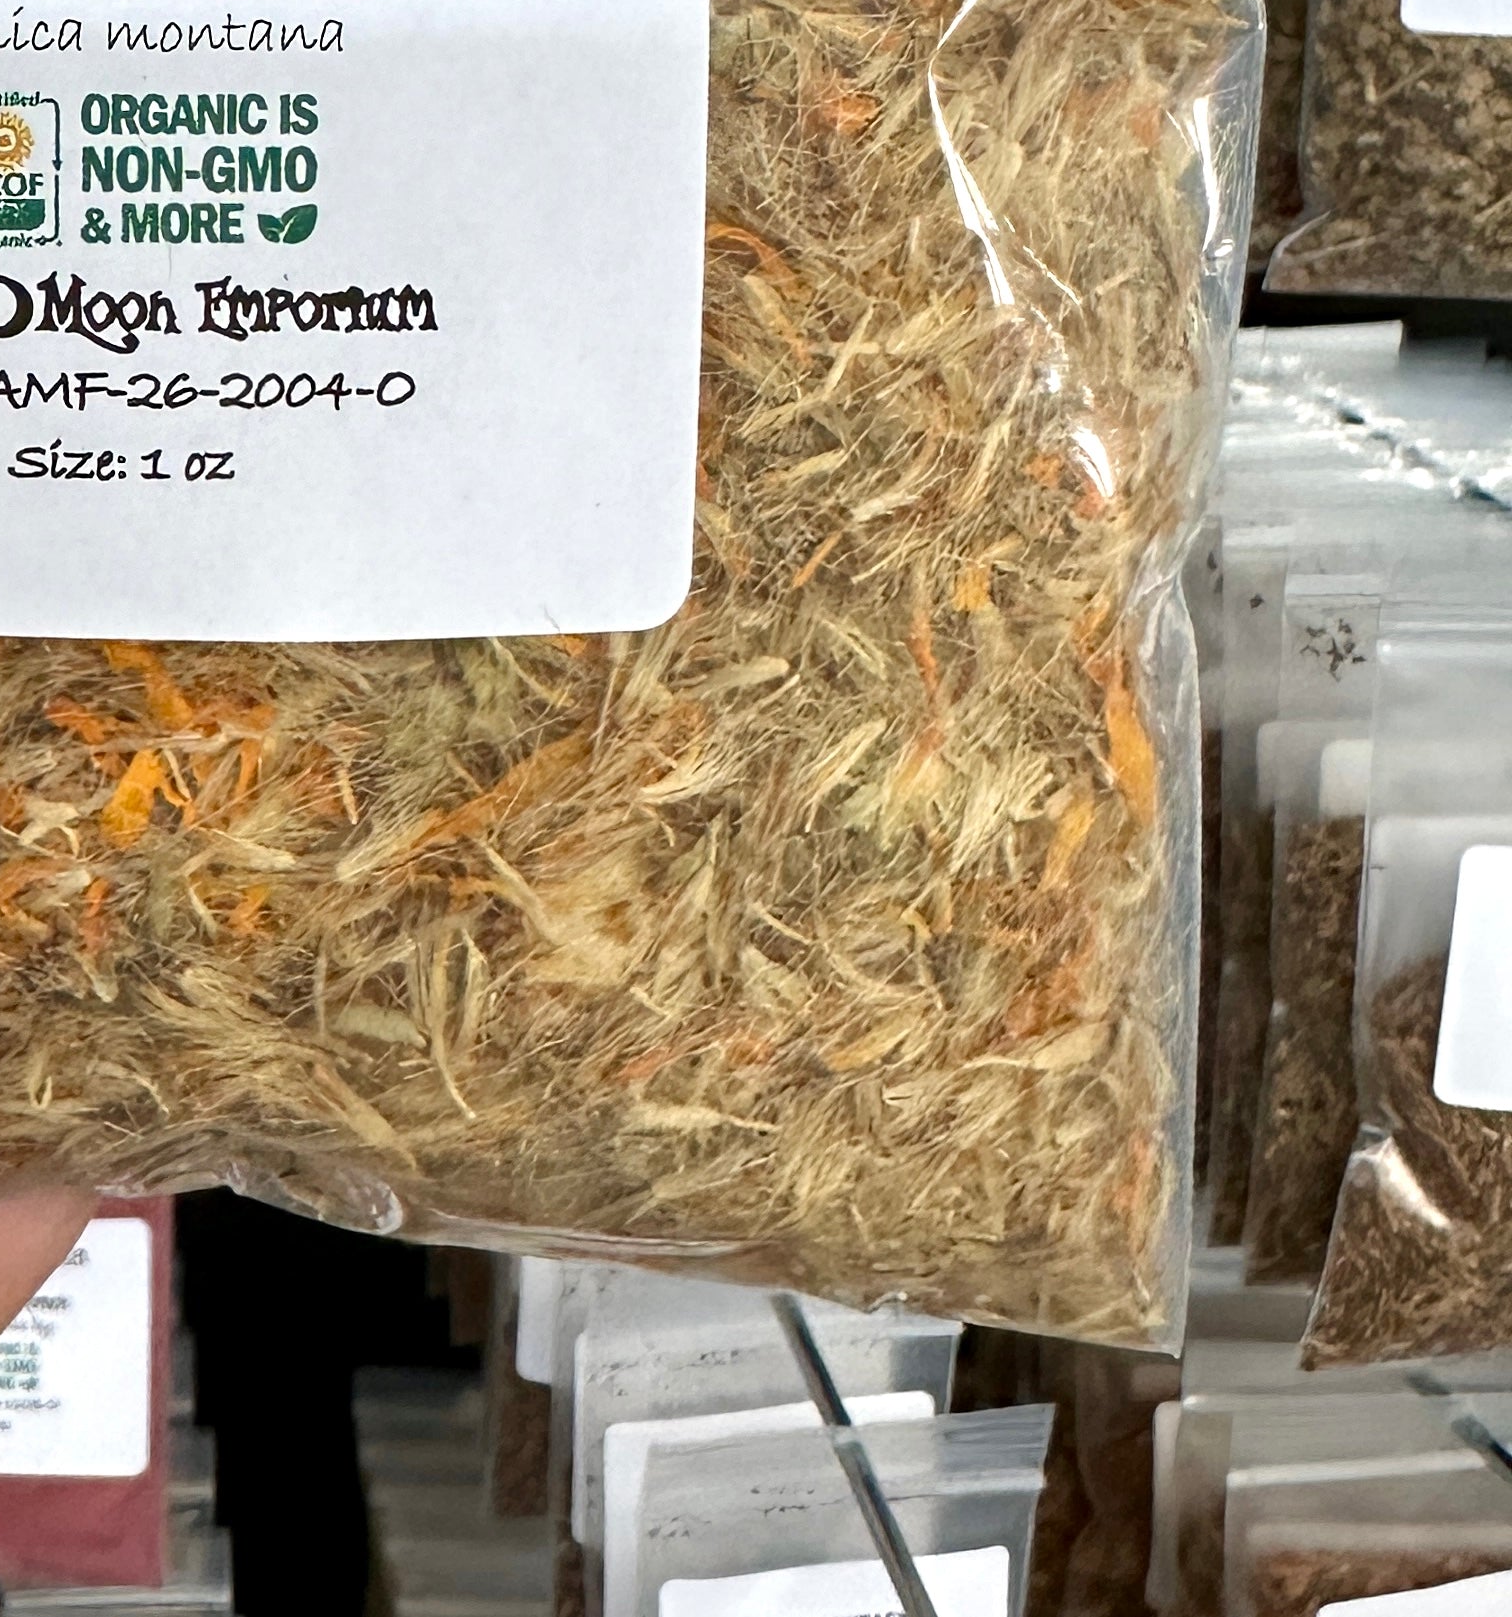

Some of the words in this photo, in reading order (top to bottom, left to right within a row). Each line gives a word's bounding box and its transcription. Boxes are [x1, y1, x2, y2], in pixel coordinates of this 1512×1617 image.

[108, 13, 343, 52] montana
[81, 93, 268, 135] ORGANIC
[280, 94, 318, 135] IS
[82, 146, 318, 193] NON-GMO
[81, 208, 111, 244] &
[121, 203, 244, 244] MORE
[35, 271, 182, 354] Moon
[8, 439, 126, 481] Size:
[141, 449, 171, 479] 1
[185, 452, 235, 481] oz
